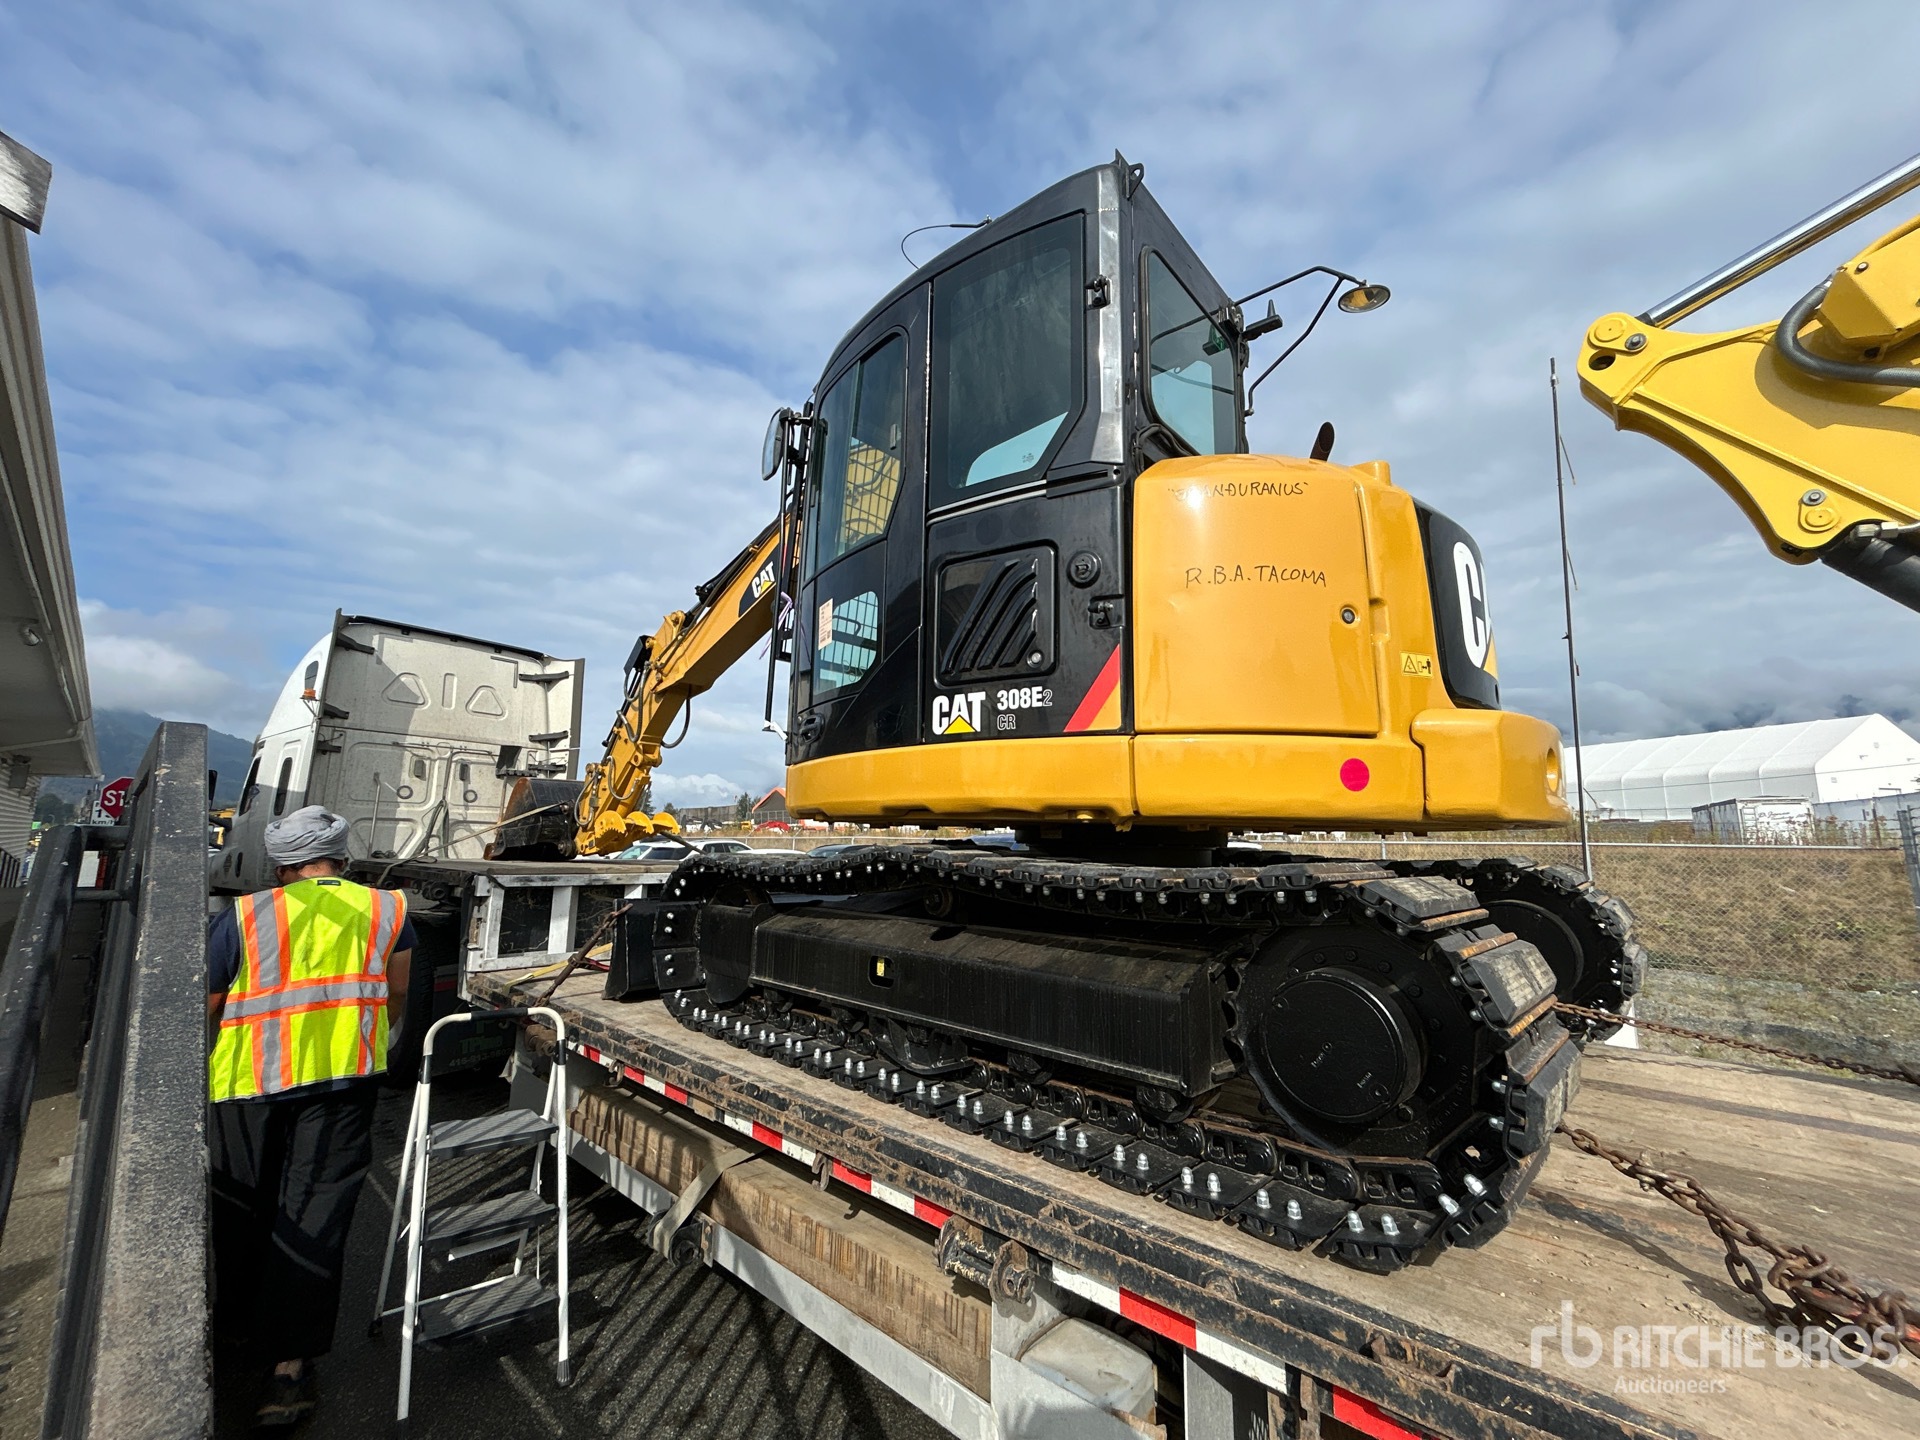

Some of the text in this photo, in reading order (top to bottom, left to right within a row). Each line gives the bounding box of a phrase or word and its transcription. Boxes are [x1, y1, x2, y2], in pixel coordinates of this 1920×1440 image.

[751, 560, 775, 599] CAT
[932, 691, 986, 735] CAT
[996, 713, 1017, 731] CR
[104, 790, 125, 806] ST
